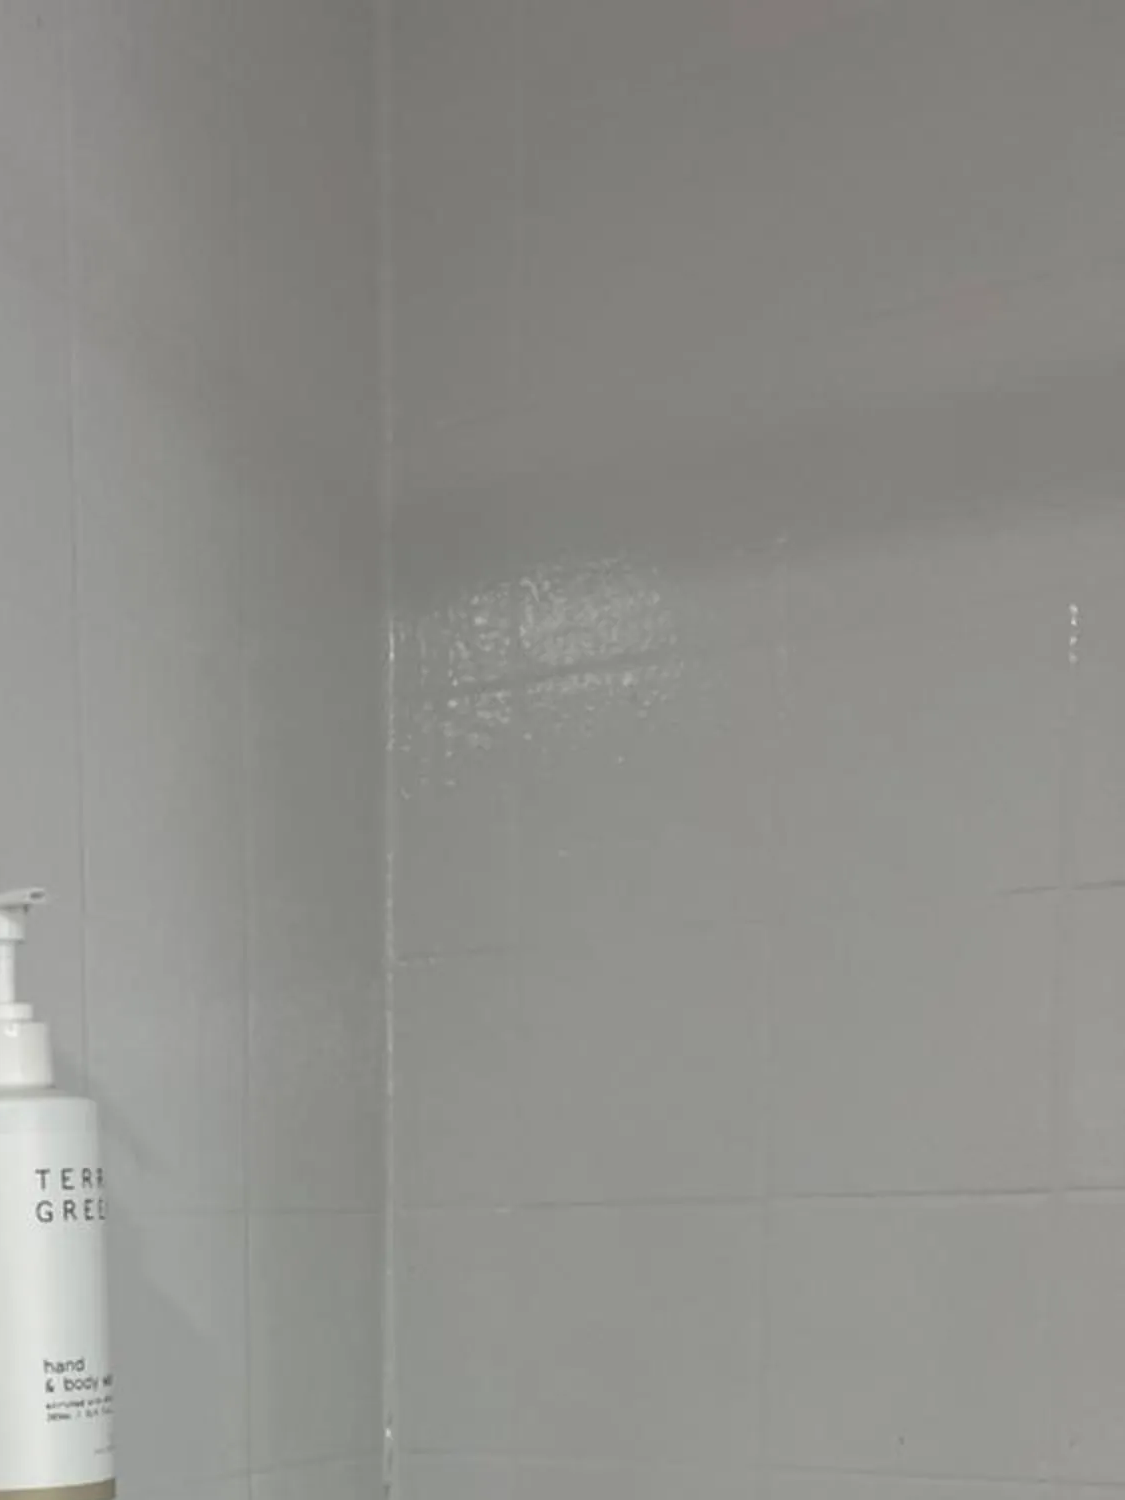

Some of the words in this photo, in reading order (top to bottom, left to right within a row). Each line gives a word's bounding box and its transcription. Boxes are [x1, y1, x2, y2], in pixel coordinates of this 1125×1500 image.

[35, 1167, 105, 1191] TERR
[35, 1198, 108, 1223] GREE
[43, 1357, 85, 1374] hand
[63, 1376, 99, 1394] body
